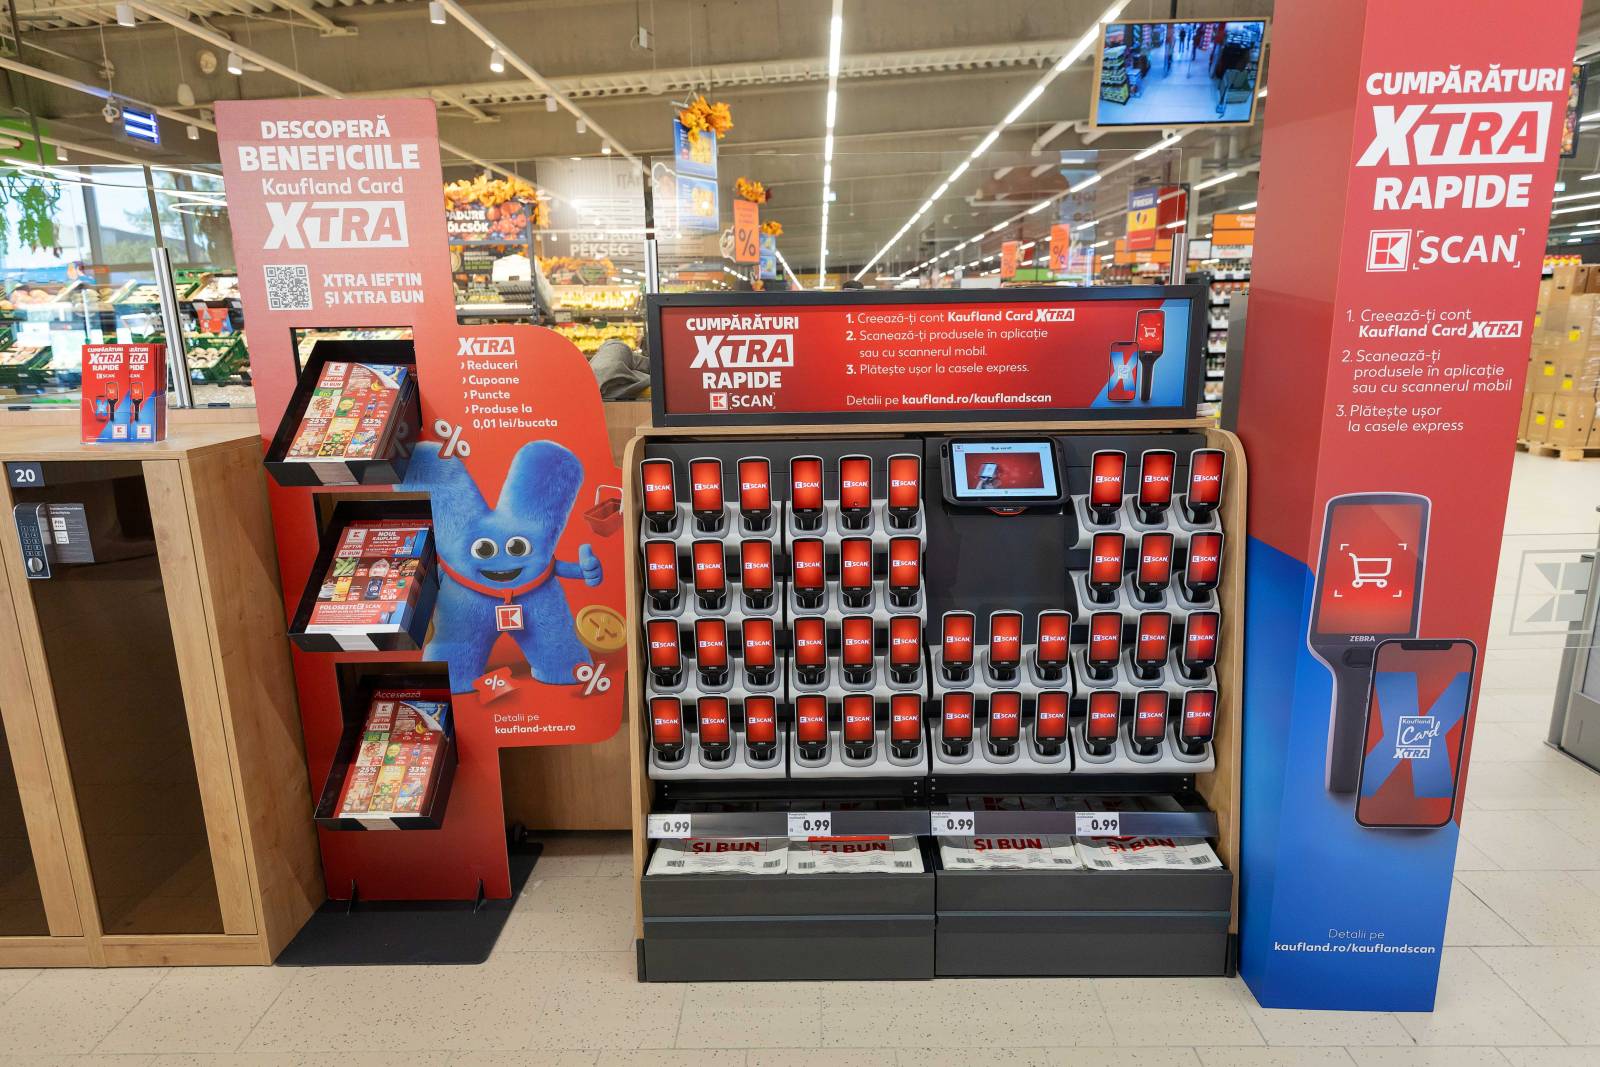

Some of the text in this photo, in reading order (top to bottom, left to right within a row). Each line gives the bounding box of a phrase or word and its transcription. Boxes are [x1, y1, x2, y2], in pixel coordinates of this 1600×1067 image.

[1366, 64, 1566, 96] CUMPĂRĂTURI
[260, 114, 391, 139] DESCOPERĂ
[1355, 102, 1552, 166] XTRA
[238, 143, 420, 172] BENEFICIILE
[262, 176, 404, 196] Kaufland Card
[1373, 174, 1532, 210] RAPIDE
[263, 200, 409, 249] XTRA
[1418, 234, 1518, 264] SCAN
[323, 272, 422, 287] XTRA IEFTIN
[342, 291, 388, 304] XTRA
[390, 290, 424, 304] BUN
[686, 314, 799, 330] CUMPĂRĂTURI
[846, 308, 1075, 325] 1. Creează-ți cont Kaufland Card XTRA
[1346, 309, 1472, 324] 1. Creează-ți cont
[846, 328, 1048, 344] 2. Scanează-ți produsele în aplicație
[1358, 320, 1522, 338] Kaufland Card XTRA
[457, 336, 515, 356] XTRA
[690, 334, 794, 368] XTRA
[860, 346, 987, 358] sau cu scannerul mobil.
[88, 353, 124, 364] XTRA
[1342, 350, 1440, 364] 2. Scanează-ți
[467, 360, 518, 370] Reduceri
[846, 364, 1030, 377] 3. Plătește ușor la casele express.
[1354, 364, 1504, 380] produsele în aplicație
[468, 375, 520, 387] Cupoane
[702, 372, 782, 388] RAPIDE
[1352, 379, 1512, 393] sau cu scannerul mobil
[470, 390, 510, 400] Puncte
[732, 394, 774, 407] SCAN
[846, 393, 1052, 408] Detalii pe kaufland.ro/kauflandscan
[472, 403, 532, 414] Produse la
[1336, 404, 1442, 420] 3. Plătește ușor
[473, 418, 558, 430] 0,01 lei/bucata
[1348, 420, 1464, 434] la casele express
[15, 469, 36, 482] 20
[494, 714, 540, 724] Detalii pe
[495, 724, 576, 735] kaufland-xtra.ro
[1402, 722, 1440, 744] Card
[1393, 747, 1430, 758] XTRA
[663, 822, 690, 834] 0.99
[803, 820, 830, 831] 0.99
[946, 819, 974, 830] 0.99
[1091, 819, 1118, 830] 0.99
[716, 842, 760, 853] BUN
[844, 842, 886, 853] BUN
[998, 838, 1042, 850] BUN
[1328, 928, 1385, 942] Detalii pe
[1274, 942, 1436, 954] kaufland.ro/kauflandscan
